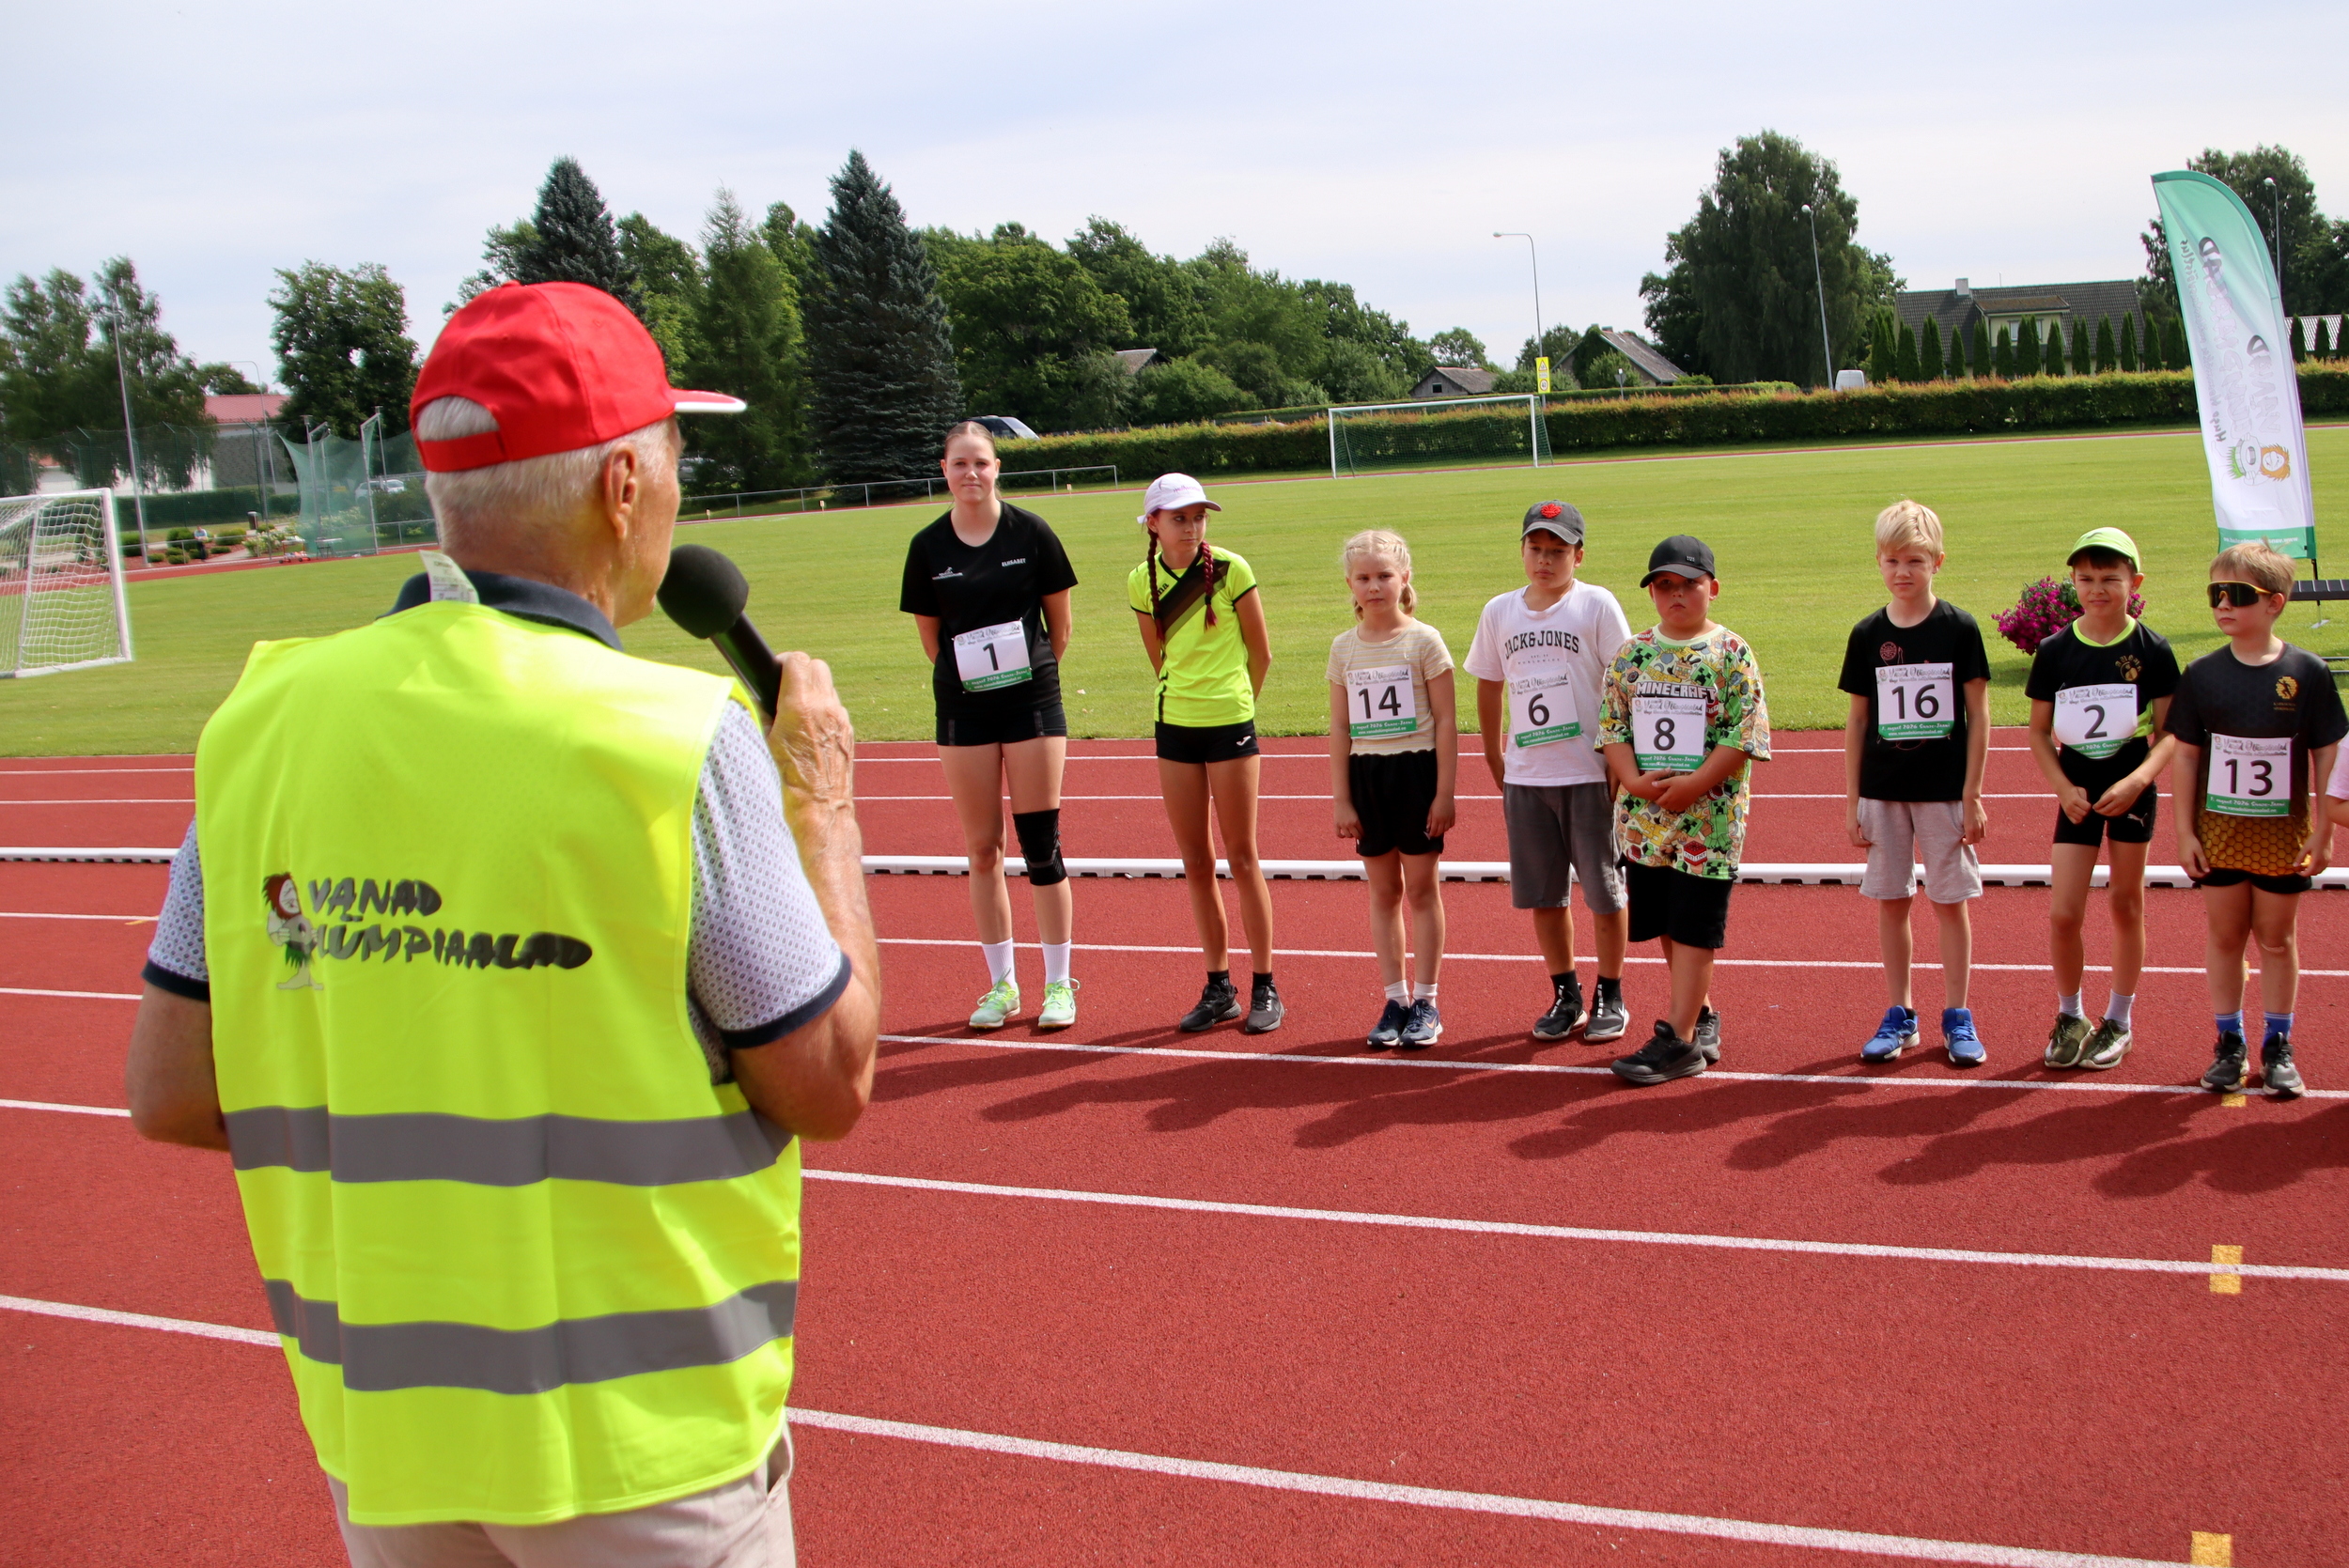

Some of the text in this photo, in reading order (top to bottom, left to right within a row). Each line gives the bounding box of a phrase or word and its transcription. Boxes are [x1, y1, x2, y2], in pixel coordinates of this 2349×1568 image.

[983, 643, 999, 671] 1
[1358, 685, 1401, 719] 14
[1529, 692, 1550, 726] 6
[1636, 681, 1717, 704] MINECRAFT
[1891, 684, 1939, 720] 16
[1654, 717, 1675, 751] 8
[2083, 704, 2108, 739] 2
[2224, 758, 2273, 797] 13
[308, 877, 443, 917] VANAD
